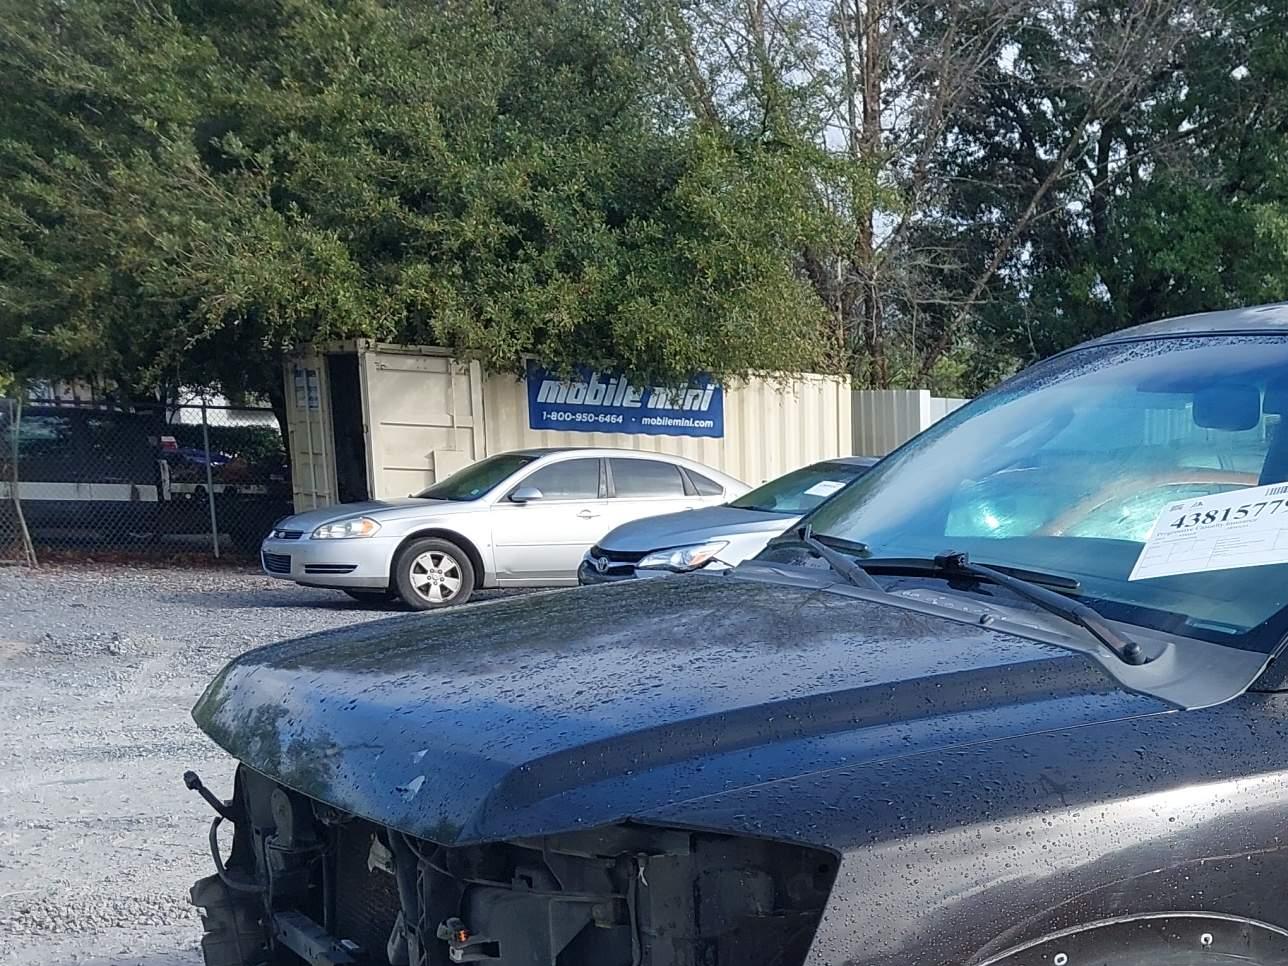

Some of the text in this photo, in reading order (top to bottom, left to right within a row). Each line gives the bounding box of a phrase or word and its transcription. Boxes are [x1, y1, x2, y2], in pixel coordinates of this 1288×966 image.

[537, 372, 642, 408] mobile
[542, 411, 714, 429] 1-800-950-6464 mobilemini.com
